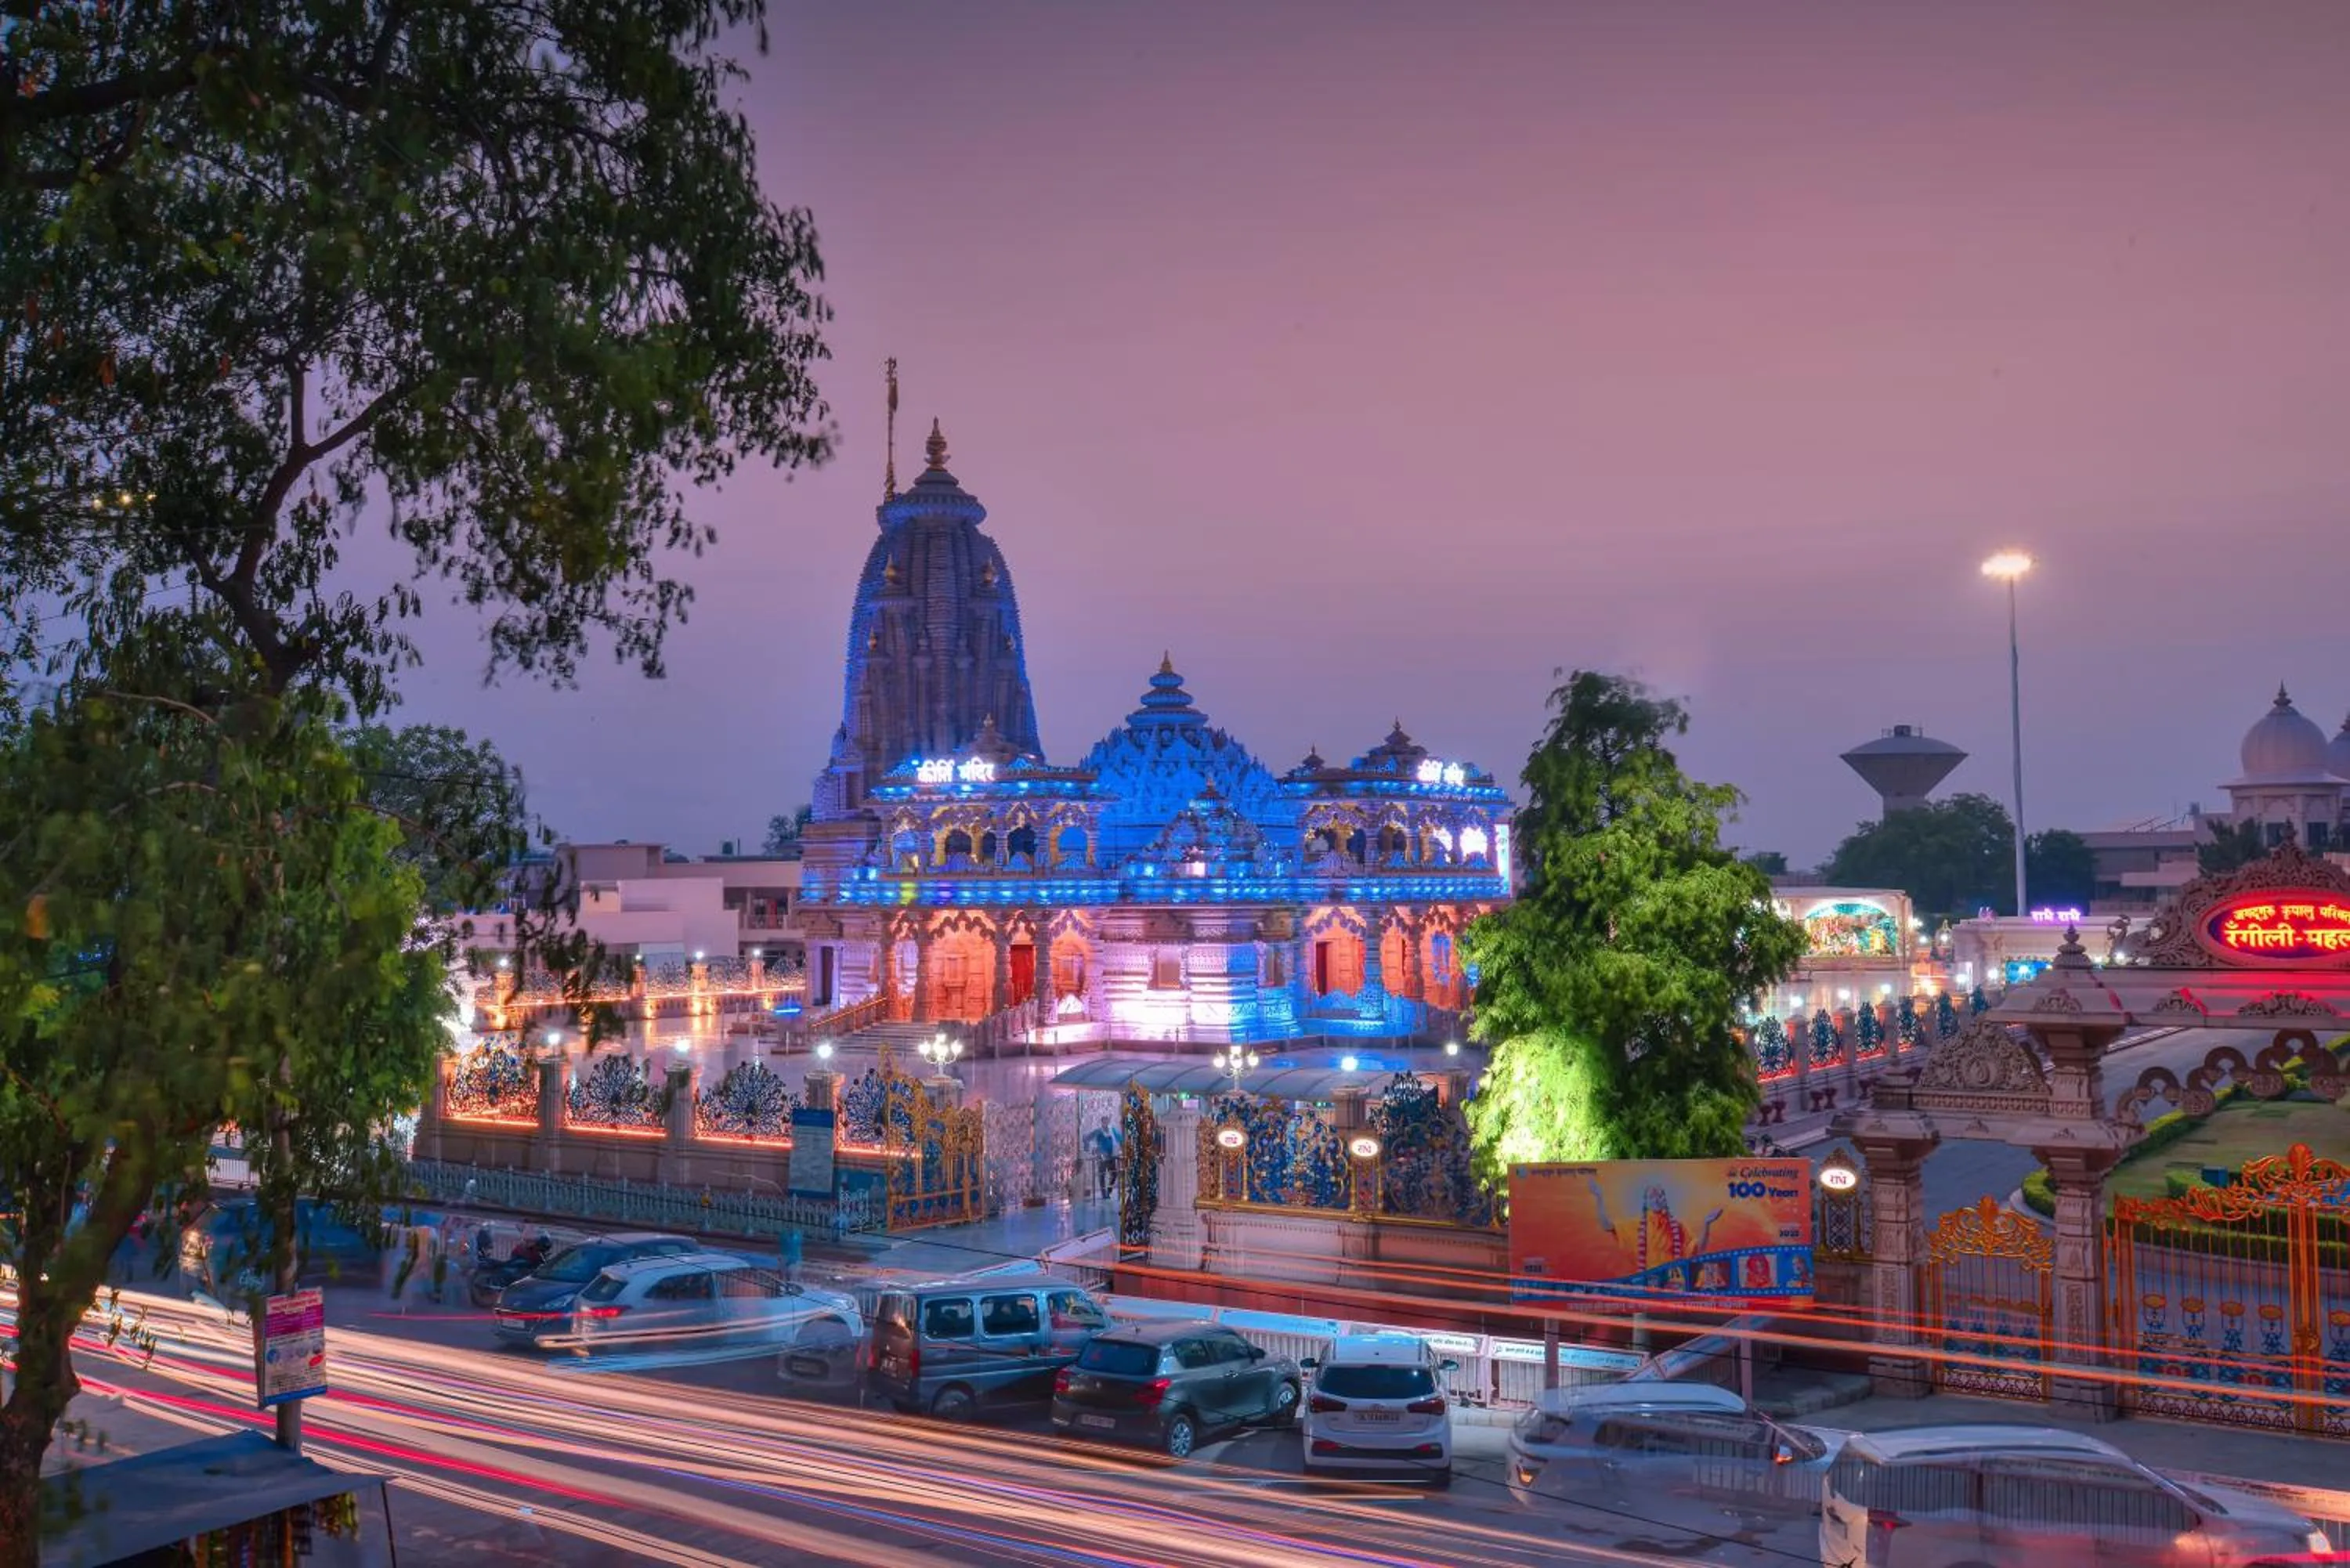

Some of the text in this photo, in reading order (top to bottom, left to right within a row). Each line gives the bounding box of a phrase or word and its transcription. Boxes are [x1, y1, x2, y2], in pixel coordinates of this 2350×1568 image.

[2281, 905, 2315, 921] कृपालु
[1740, 1166, 1799, 1180] Celebrating
[1728, 1181, 1799, 1198] 100 Years
